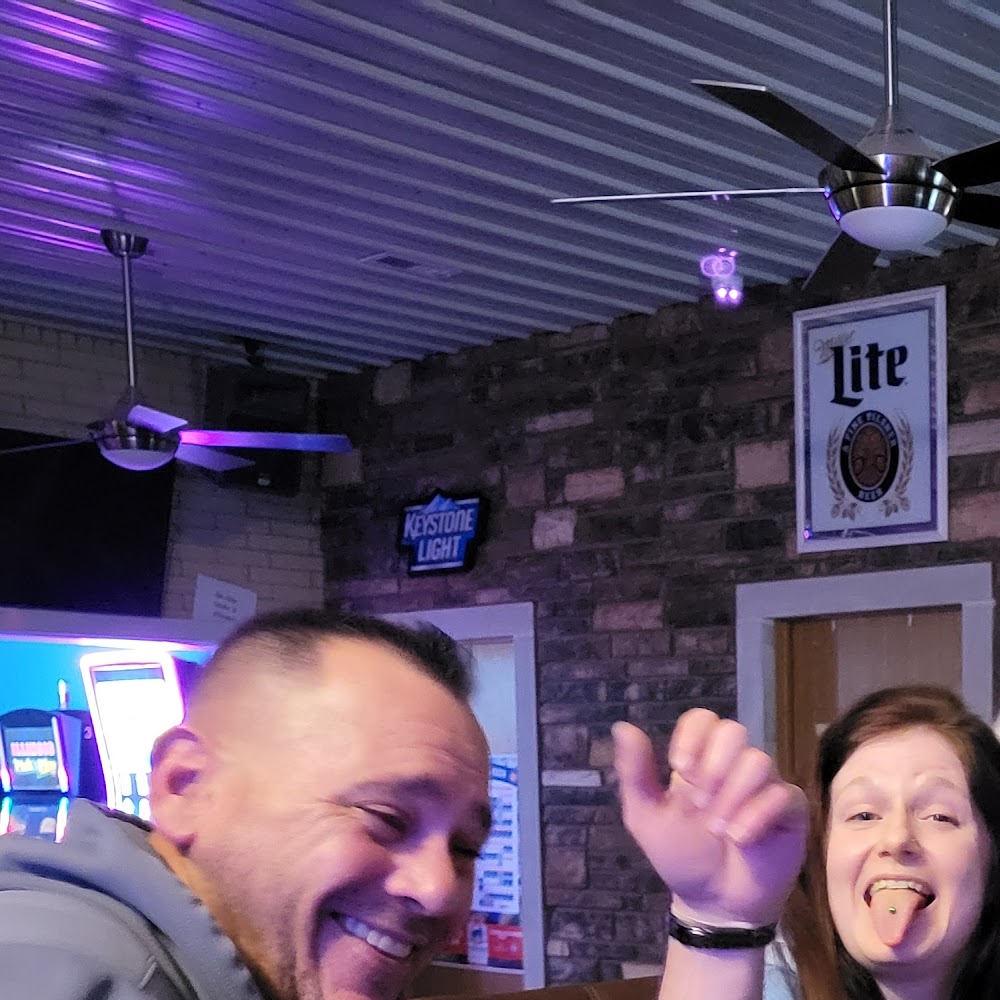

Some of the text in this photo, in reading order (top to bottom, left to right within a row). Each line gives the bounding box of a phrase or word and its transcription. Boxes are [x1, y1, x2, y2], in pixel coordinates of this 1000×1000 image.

[830, 342, 908, 407] Lite
[403, 508, 475, 540] KEYSTONE
[417, 535, 462, 563] LIGHT
